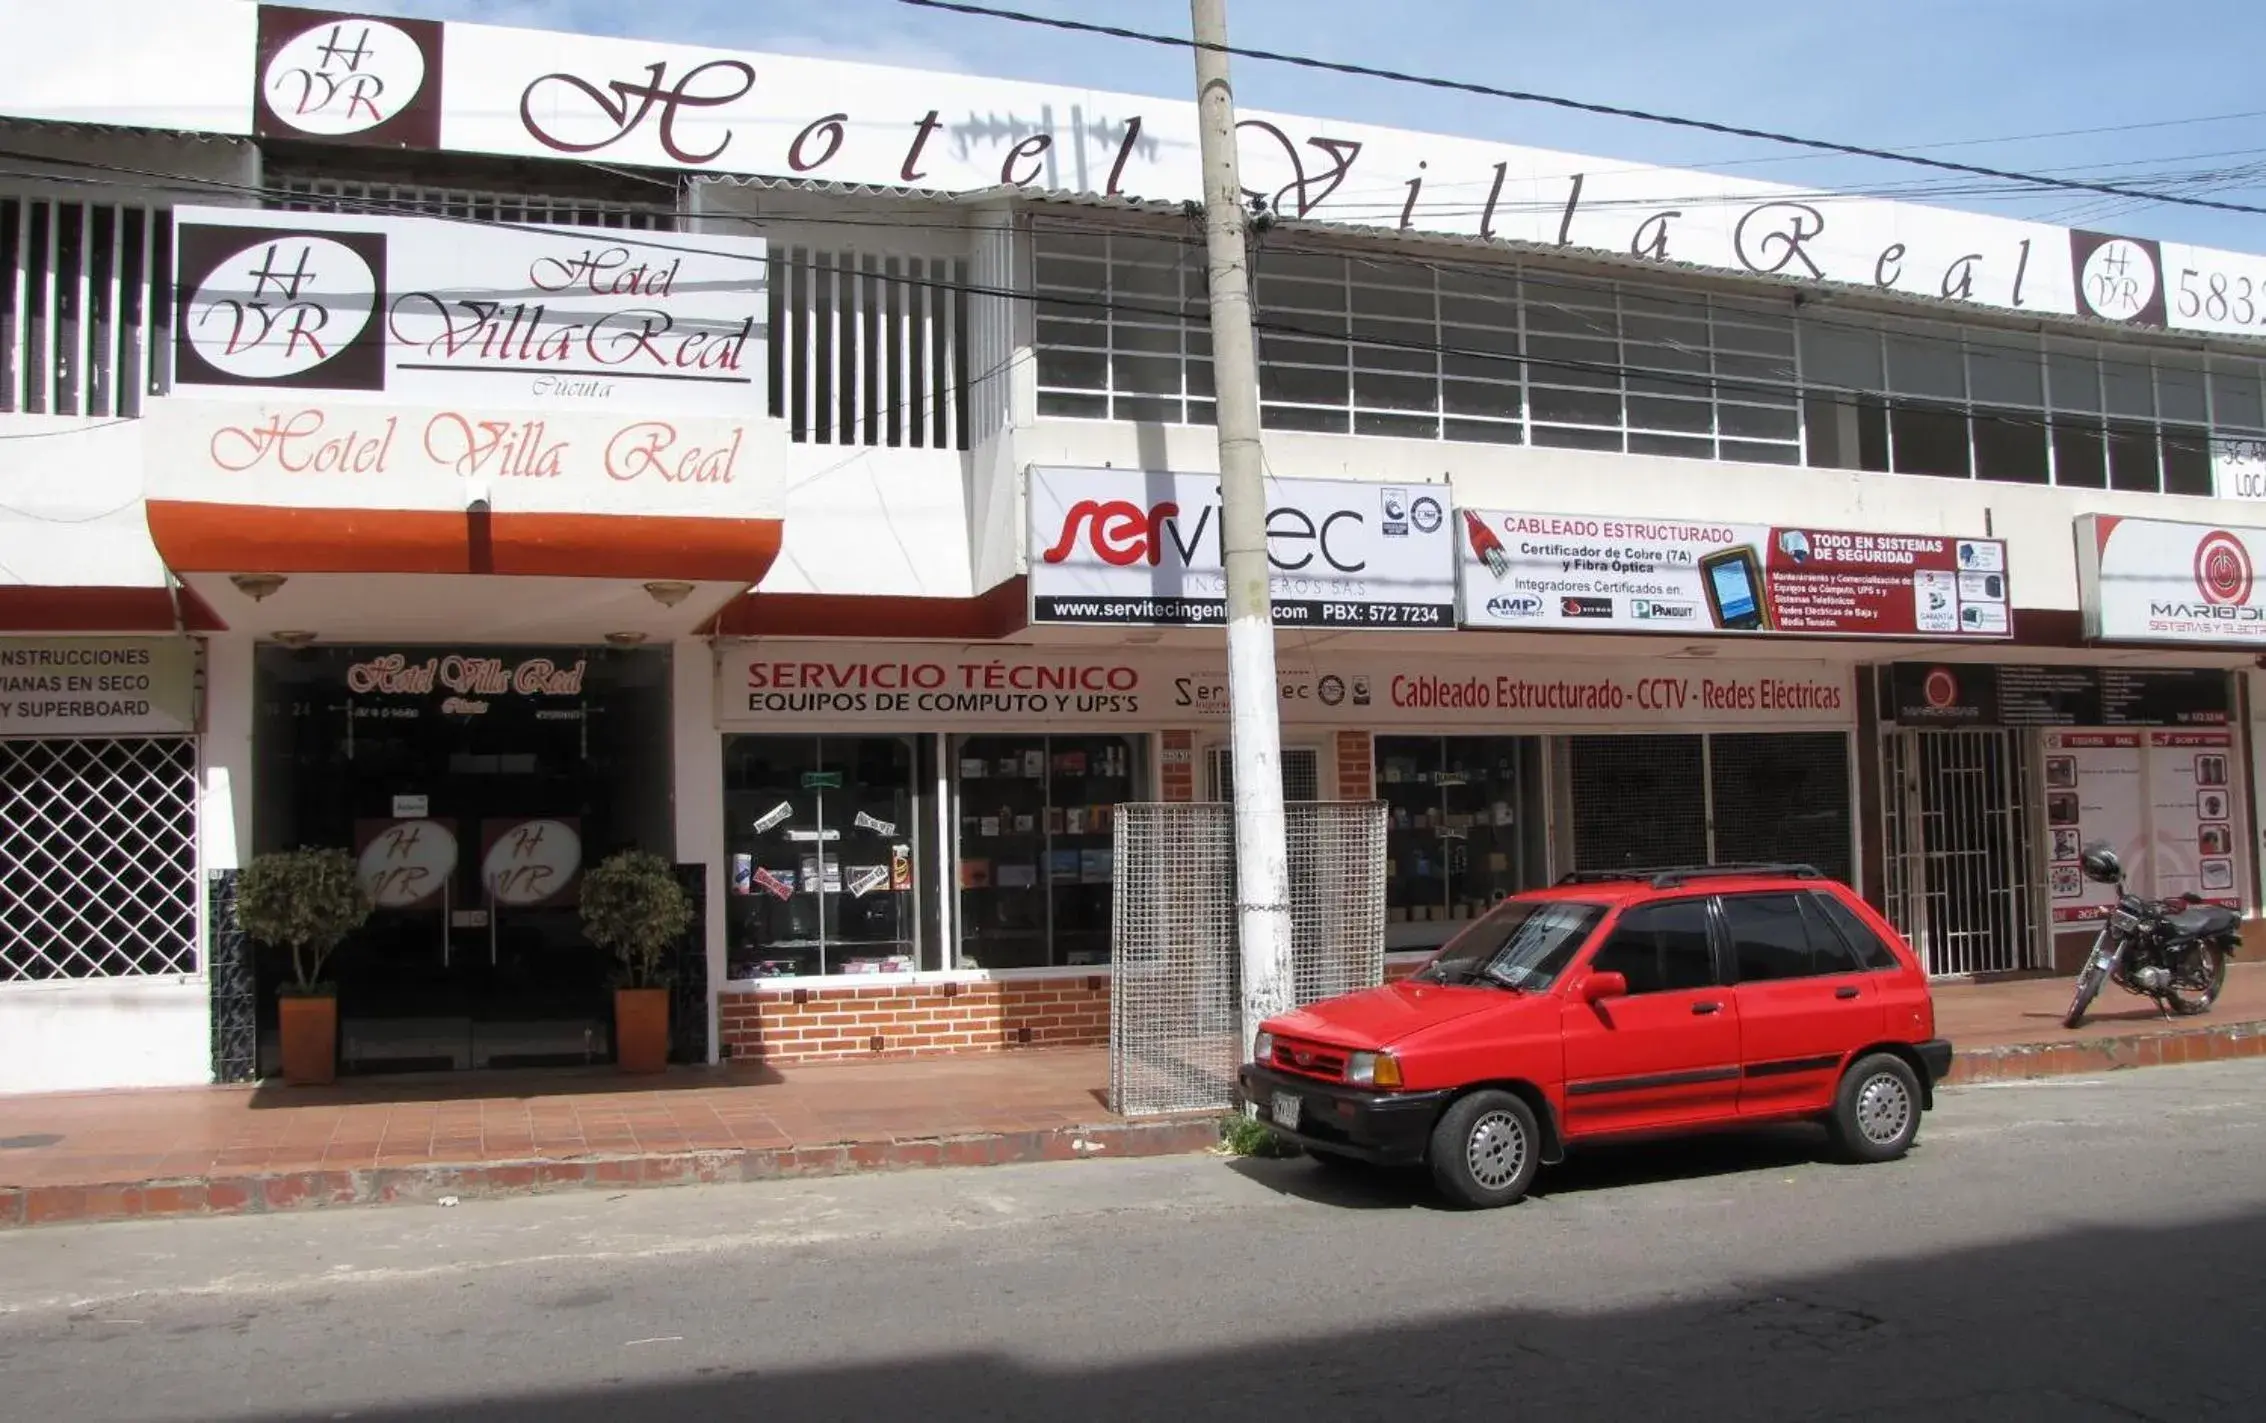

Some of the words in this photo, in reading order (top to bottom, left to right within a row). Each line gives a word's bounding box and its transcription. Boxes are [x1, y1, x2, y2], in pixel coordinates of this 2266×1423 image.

[317, 26, 373, 70] H
[520, 59, 1142, 198] Hotel
[1733, 201, 2032, 308] Real
[249, 243, 316, 300] H
[530, 247, 680, 298] Hotel
[210, 409, 397, 475] Hotel
[424, 411, 570, 477] Villa
[604, 421, 744, 485] Real
[1504, 517, 1598, 537] CABLEADO
[1603, 522, 1734, 544] ESTRUCTURADO
[1520, 543, 1602, 558] Certificador
[1605, 547, 1622, 559] de
[1625, 547, 1663, 561] Cobre
[1812, 534, 1852, 547] TODO
[1856, 535, 1875, 549] EN
[1877, 536, 1943, 553] SISTEMAS
[1562, 561, 1570, 573] y
[1574, 558, 1608, 571] Fibra
[1814, 548, 1834, 560] DE
[1836, 550, 1914, 564] SEGURIDAD
[1514, 578, 1592, 595] Integradores
[1594, 579, 1663, 596] Certificados
[1322, 604, 1364, 621] PBX:
[1369, 605, 1397, 622] 572
[1401, 606, 1440, 623] 7234
[1487, 599, 1537, 610] AMP
[67, 675, 93, 692] EN
[98, 674, 150, 691] SECO
[747, 661, 945, 690] SERVICIO
[957, 658, 1139, 691] TÉCNICO
[748, 691, 867, 713] EQUIPOS
[874, 692, 911, 711] DE
[916, 692, 1048, 712] COMPUTO
[1054, 692, 1069, 712] Y
[1391, 674, 1491, 709] Cableado
[1497, 676, 1623, 709] Estructurado
[1637, 679, 1690, 710] CCTV
[1702, 679, 1756, 710] Redes
[1760, 678, 1842, 710] Eléctricas
[17, 700, 150, 719] SUPERBOARD
